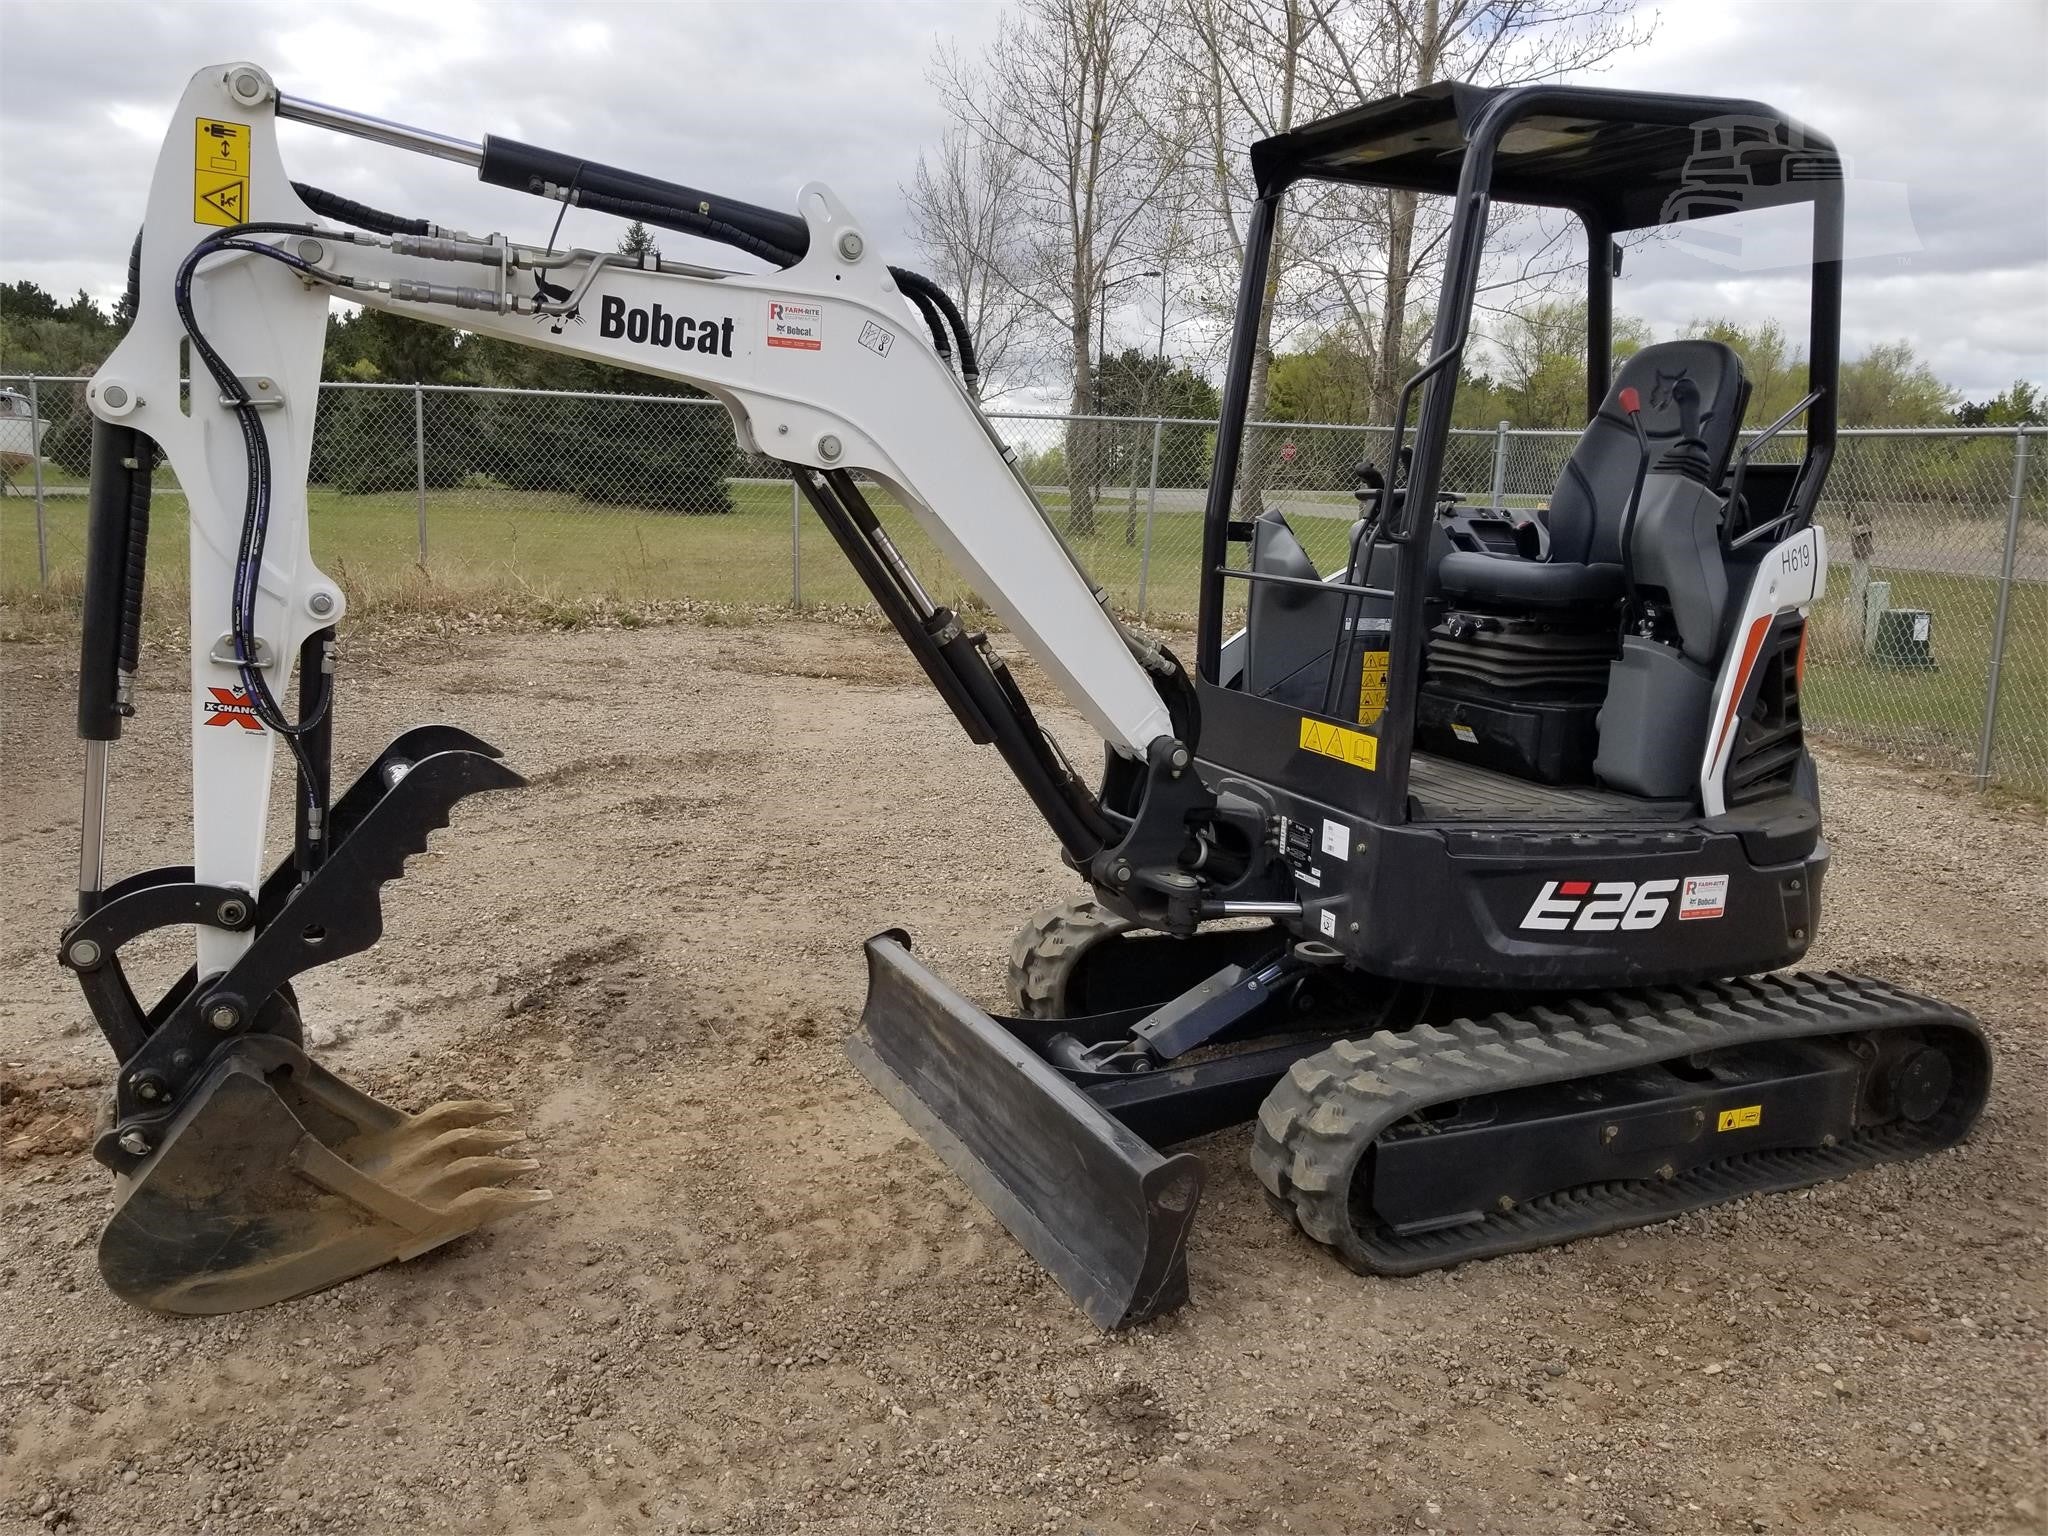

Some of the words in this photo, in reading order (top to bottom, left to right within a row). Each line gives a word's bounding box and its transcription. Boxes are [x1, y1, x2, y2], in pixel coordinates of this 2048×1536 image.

[784, 307, 820, 316] FARM-RITE
[600, 294, 735, 358] Bobcat
[786, 325, 812, 337] Bobcat
[1781, 544, 1810, 575] H619
[206, 702, 258, 715] X-CHANG
[1519, 878, 1680, 930] E26
[1697, 897, 1718, 906] Bobcat
